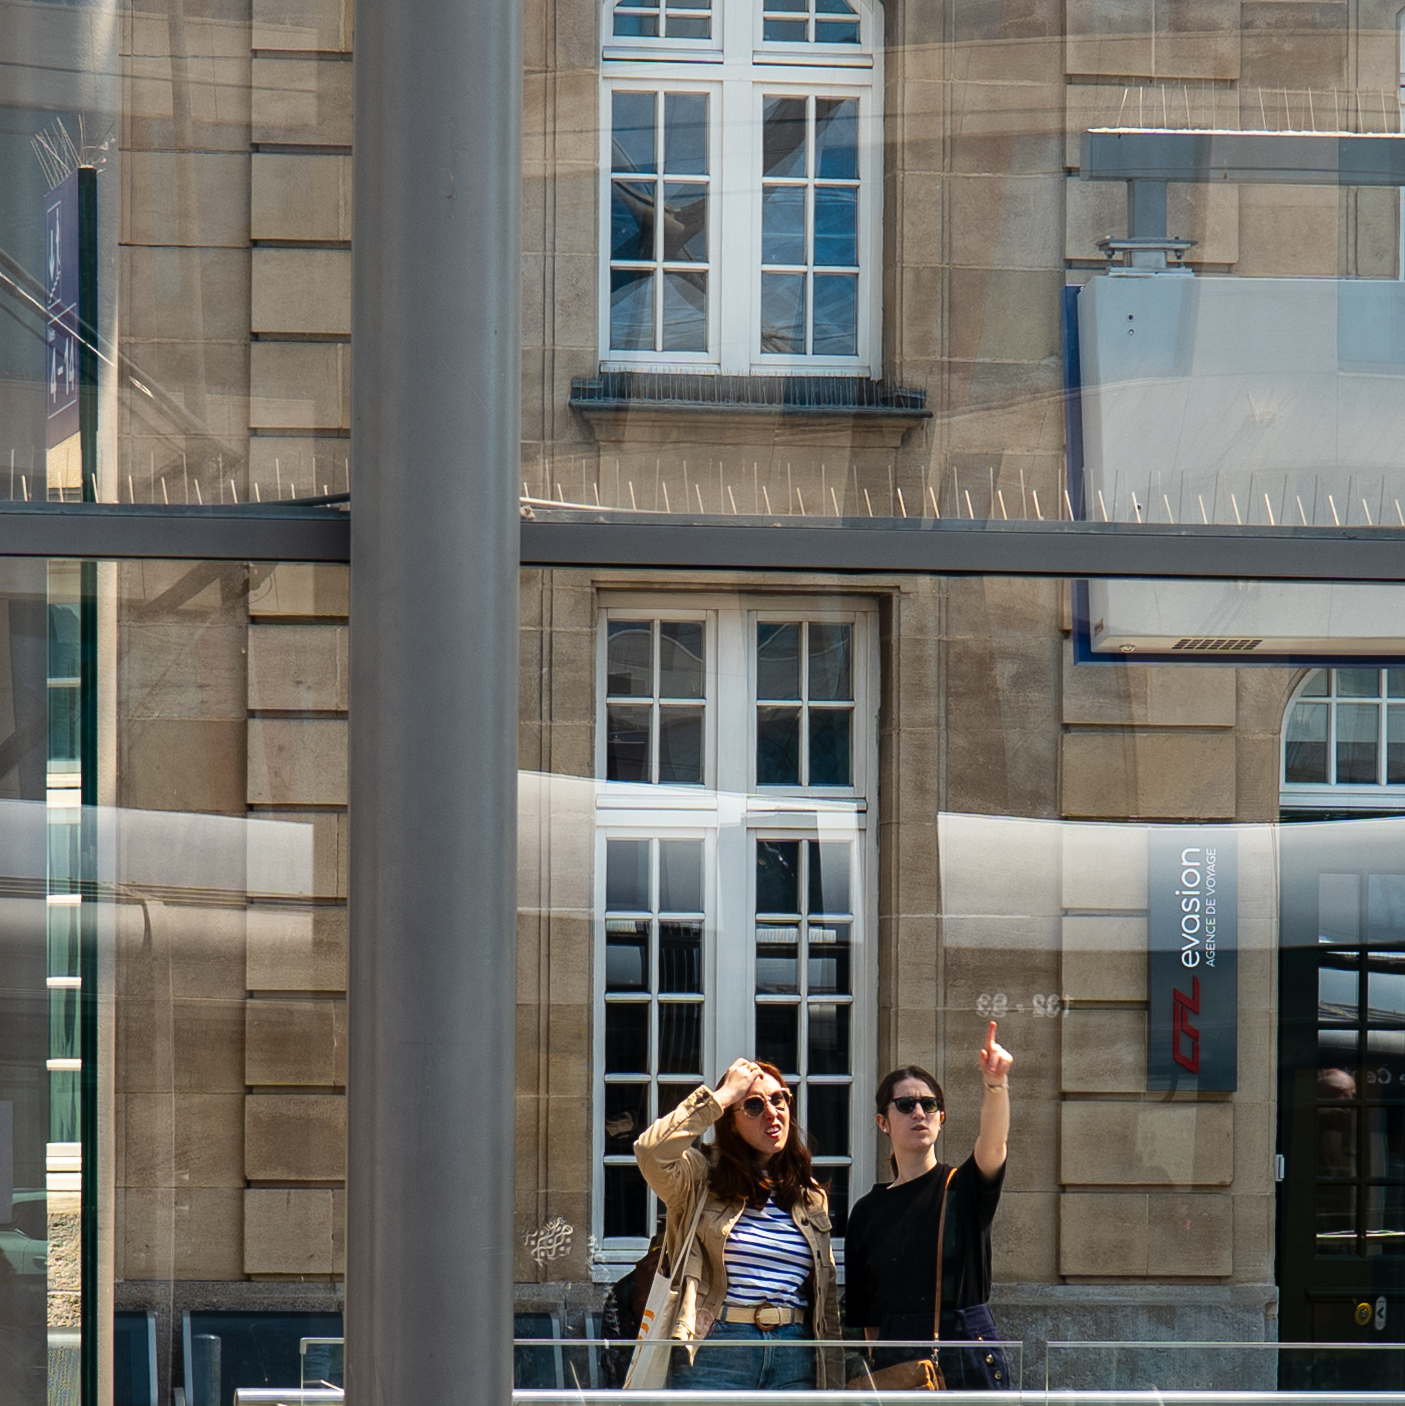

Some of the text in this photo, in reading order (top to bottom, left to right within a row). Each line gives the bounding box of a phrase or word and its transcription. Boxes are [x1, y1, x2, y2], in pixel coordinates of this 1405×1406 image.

[1172, 847, 1200, 1074] CFL evasion
[1205, 847, 1216, 967] AGENCE DE VOYAGE
